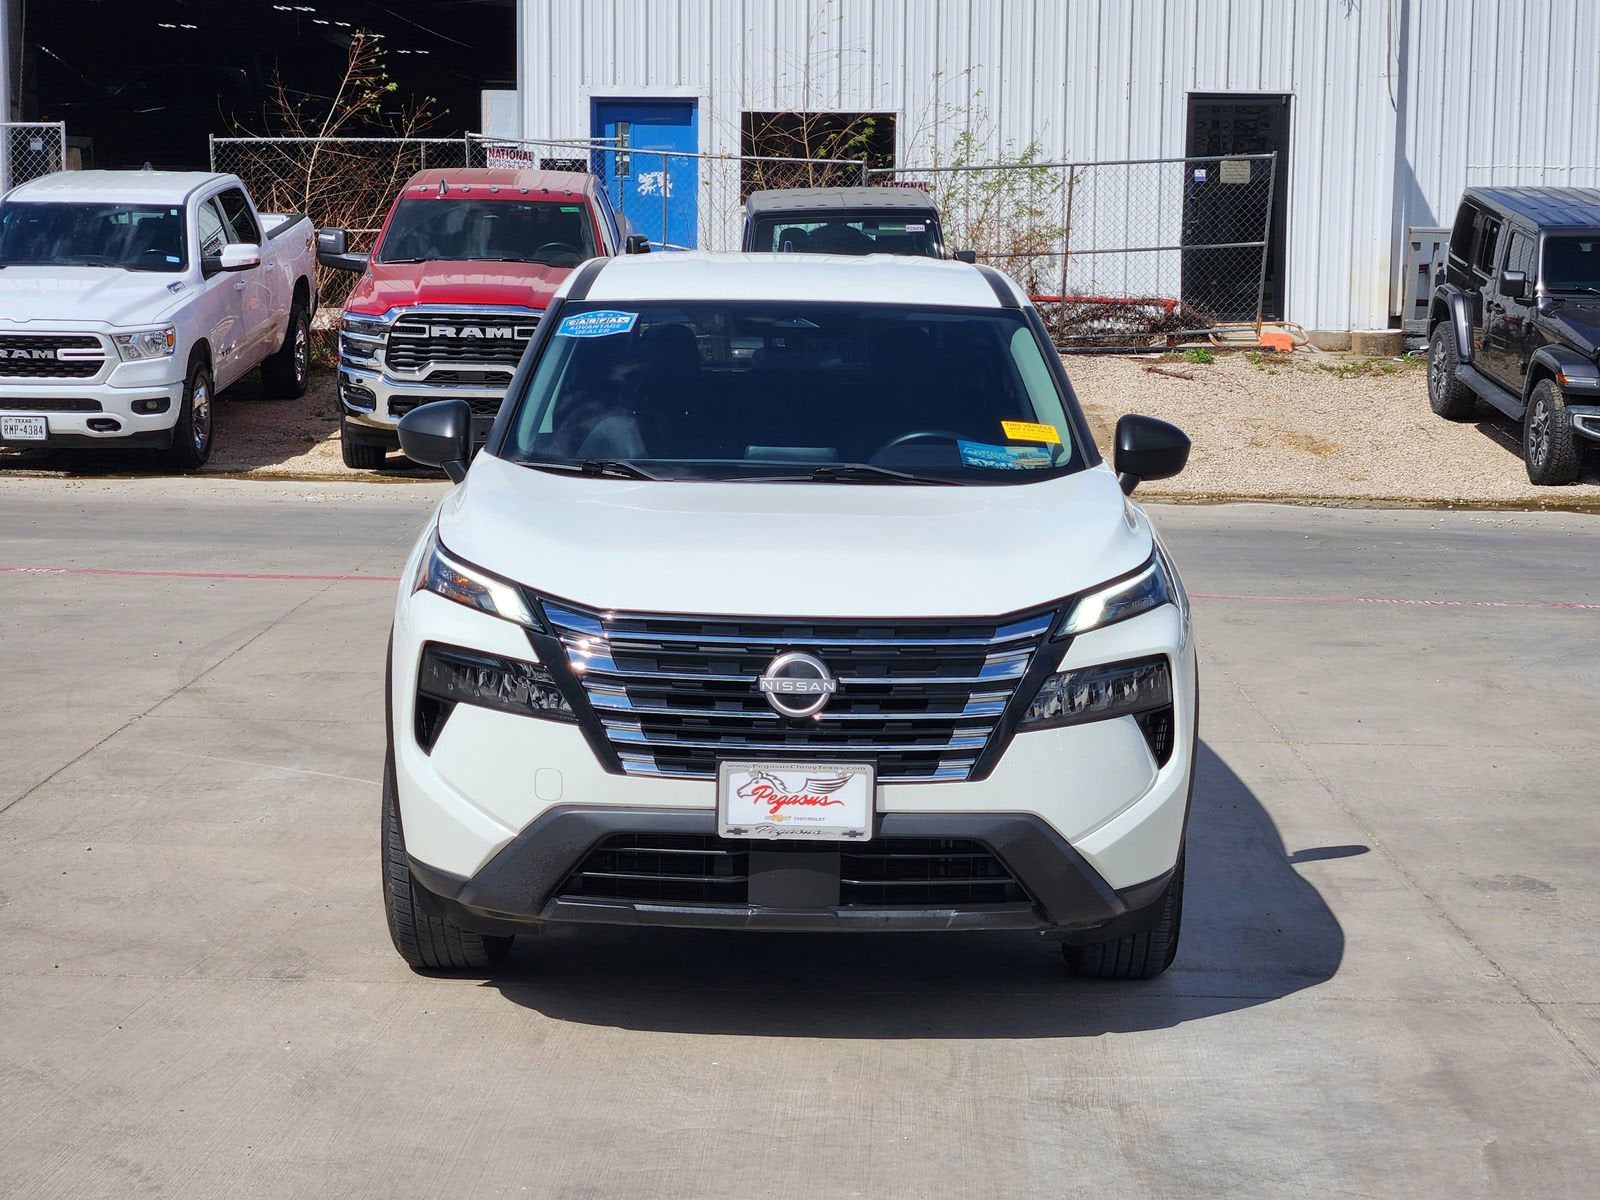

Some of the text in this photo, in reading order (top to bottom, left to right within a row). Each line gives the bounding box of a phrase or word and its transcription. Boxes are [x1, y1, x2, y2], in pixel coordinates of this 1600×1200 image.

[488, 148, 533, 161] NATIONAL
[567, 317, 628, 326] CARFAX
[430, 326, 512, 339] RAM
[761, 681, 835, 691] NISSAN
[727, 763, 867, 771] www.PegasusChevyTexas.com
[751, 785, 845, 814] Pegasus
[755, 825, 828, 838] Pegasus
